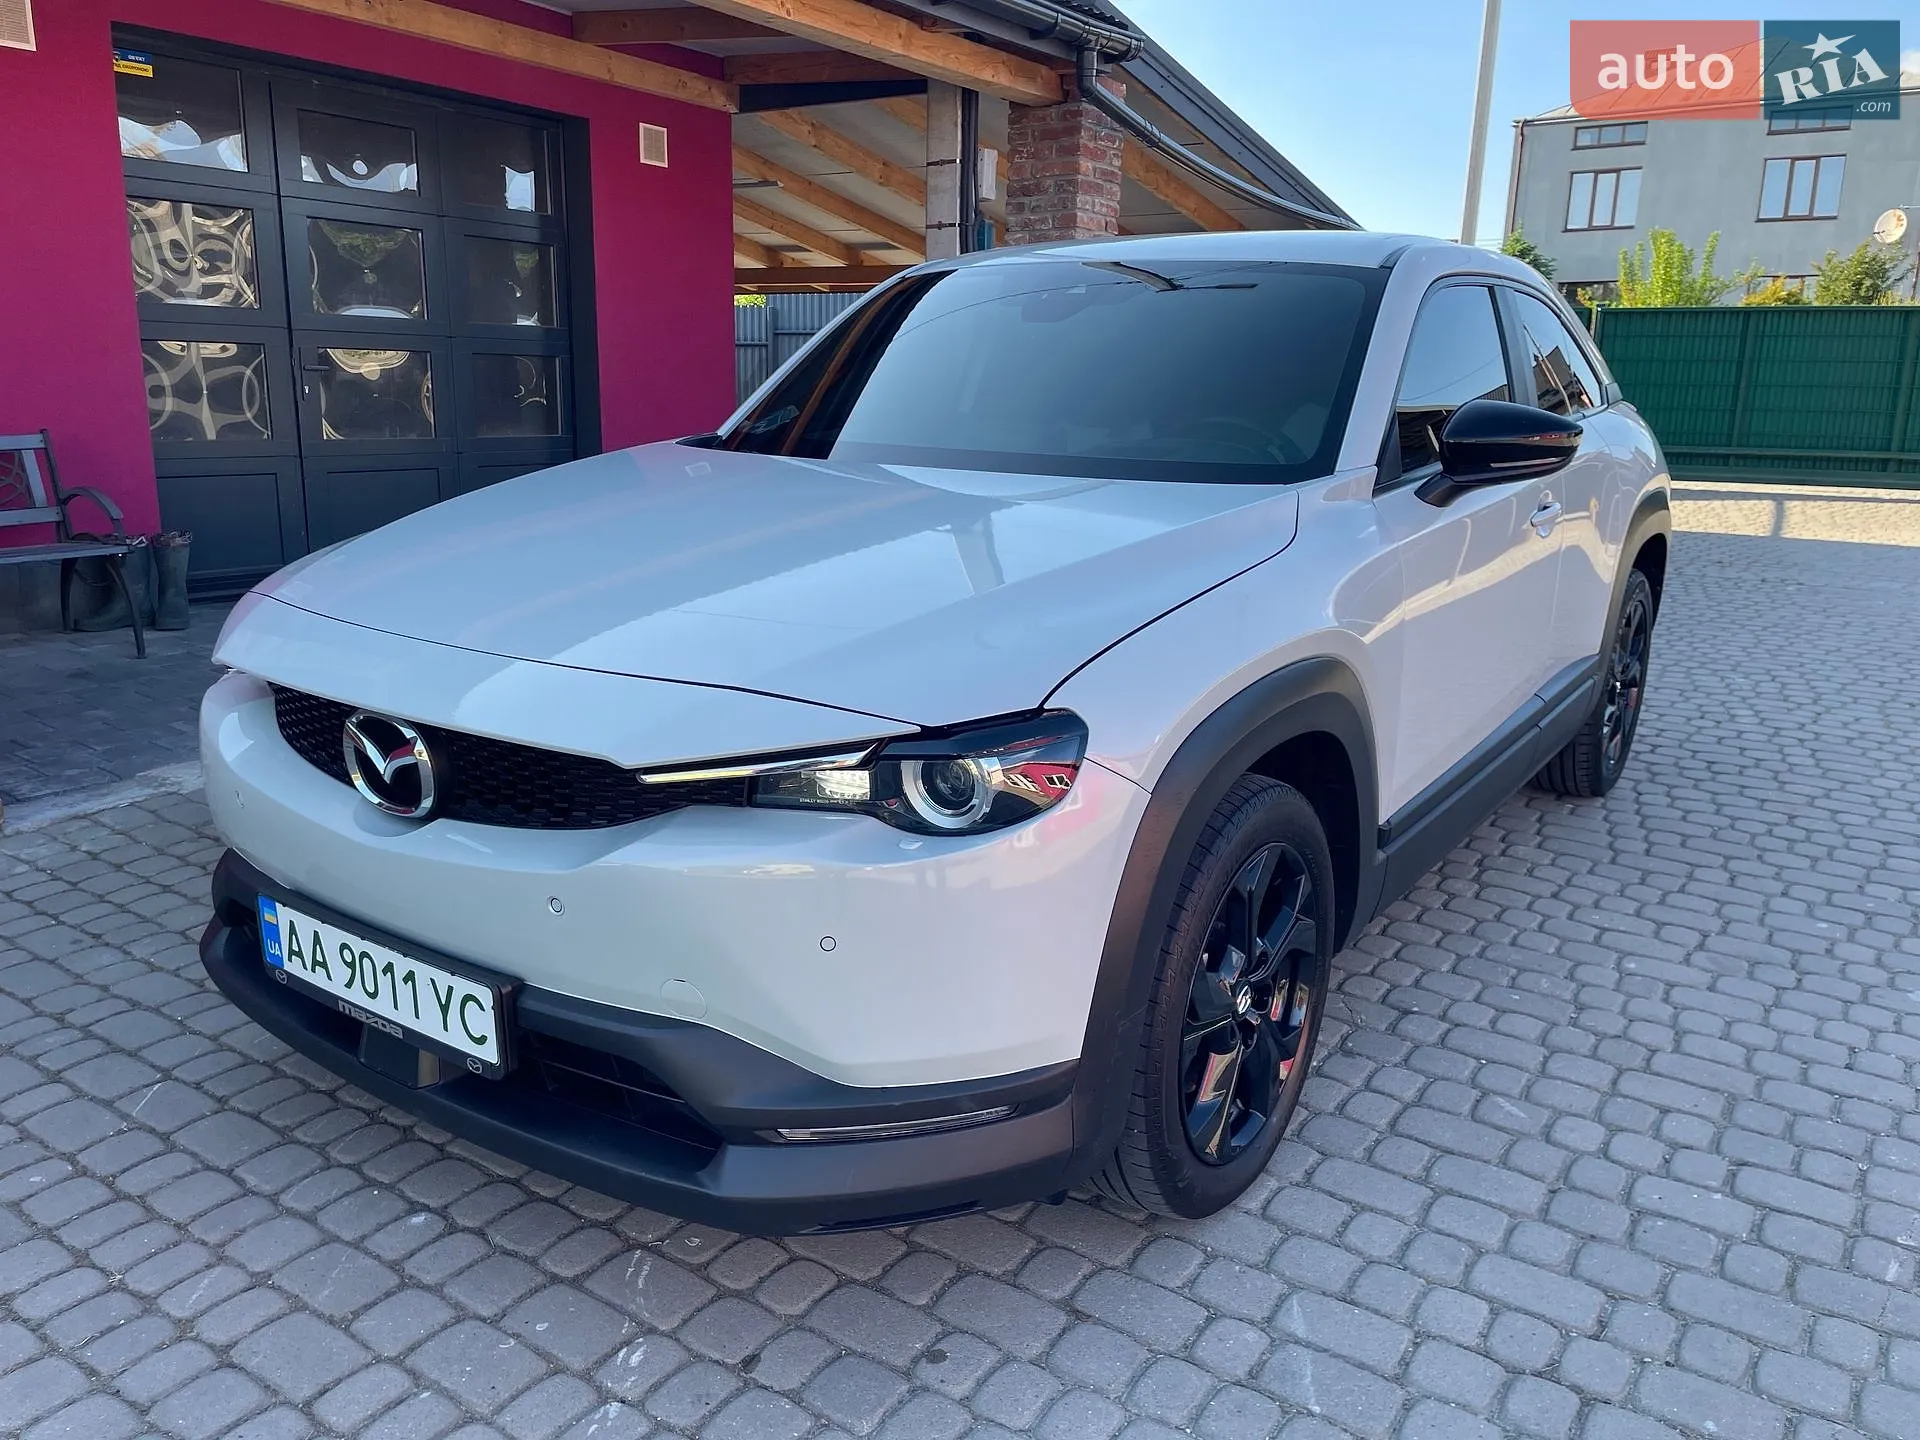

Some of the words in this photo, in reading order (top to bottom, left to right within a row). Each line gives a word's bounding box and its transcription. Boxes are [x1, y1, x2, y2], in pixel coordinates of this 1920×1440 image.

[267, 939, 282, 958] UA
[287, 919, 333, 982] AA
[338, 942, 420, 1020] 9011
[429, 976, 488, 1046] YC
[338, 999, 404, 1040] mazda
